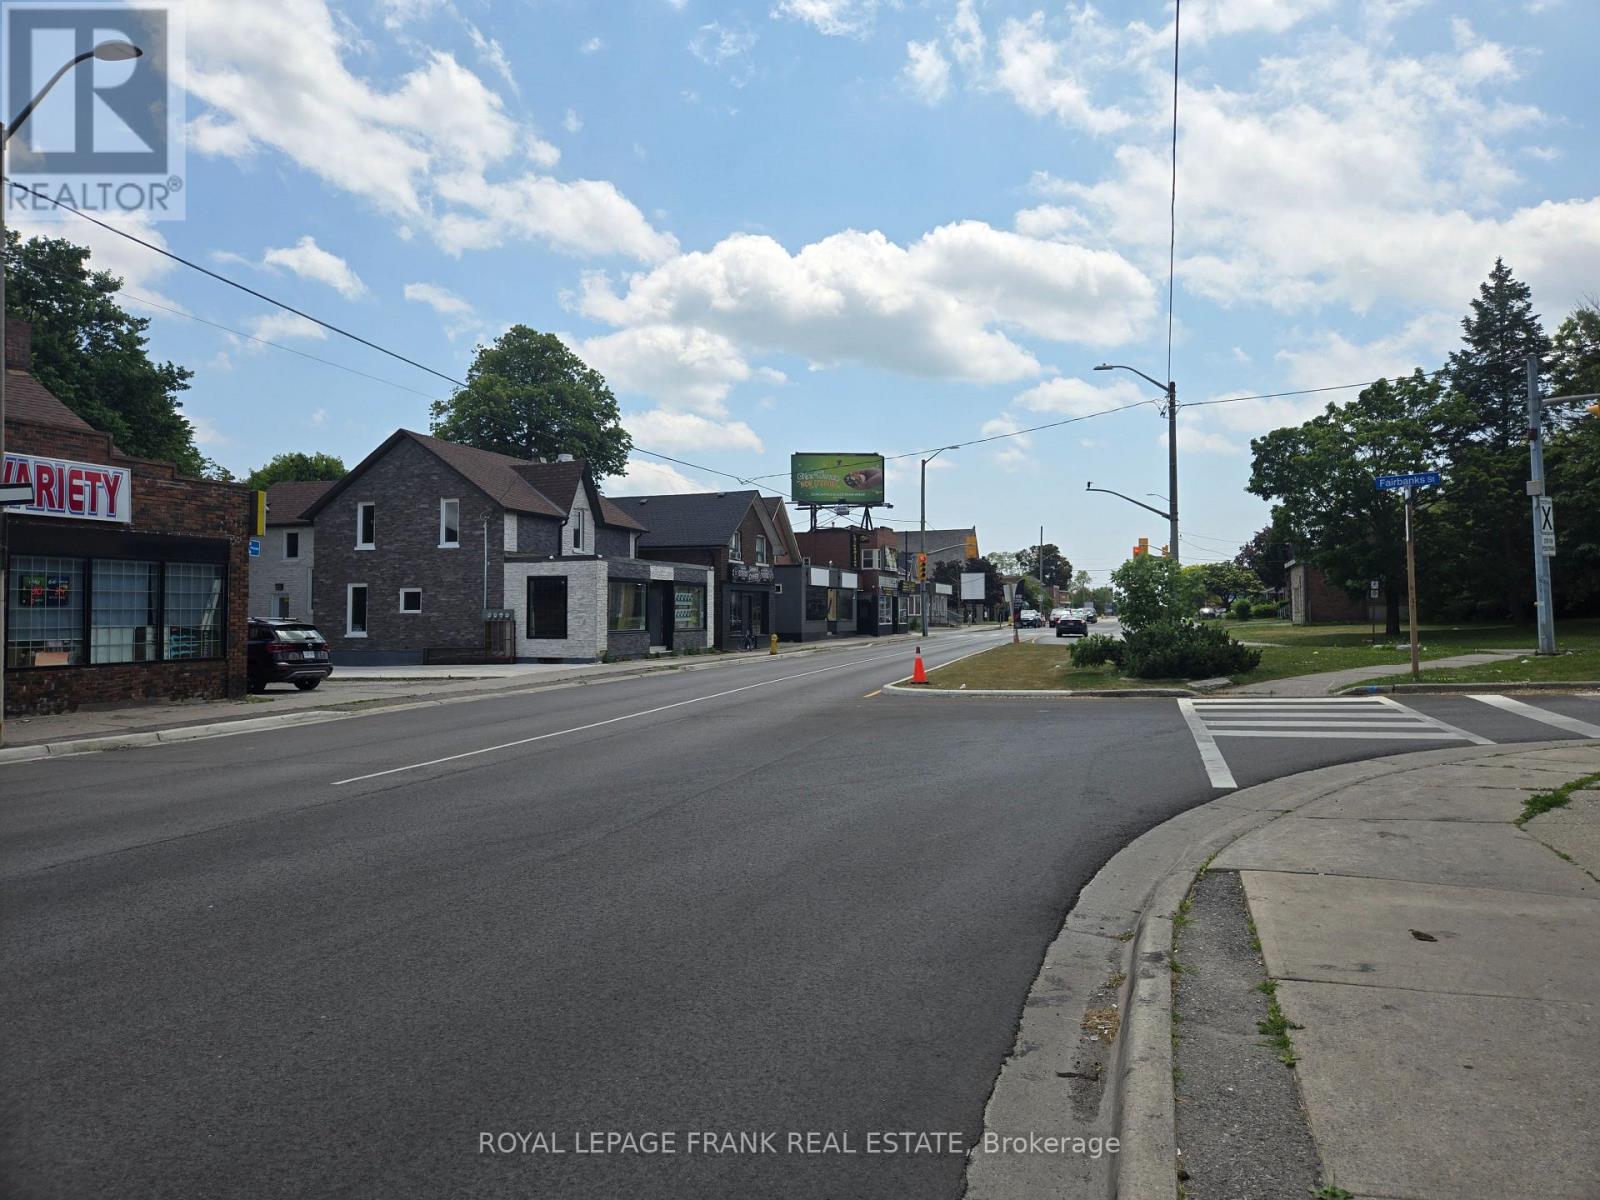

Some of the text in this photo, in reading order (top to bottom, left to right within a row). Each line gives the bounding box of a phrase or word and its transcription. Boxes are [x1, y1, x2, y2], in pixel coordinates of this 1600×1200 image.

[4, 458, 122, 517] ARIETY
[1379, 475, 1436, 488] Fairbanks St
